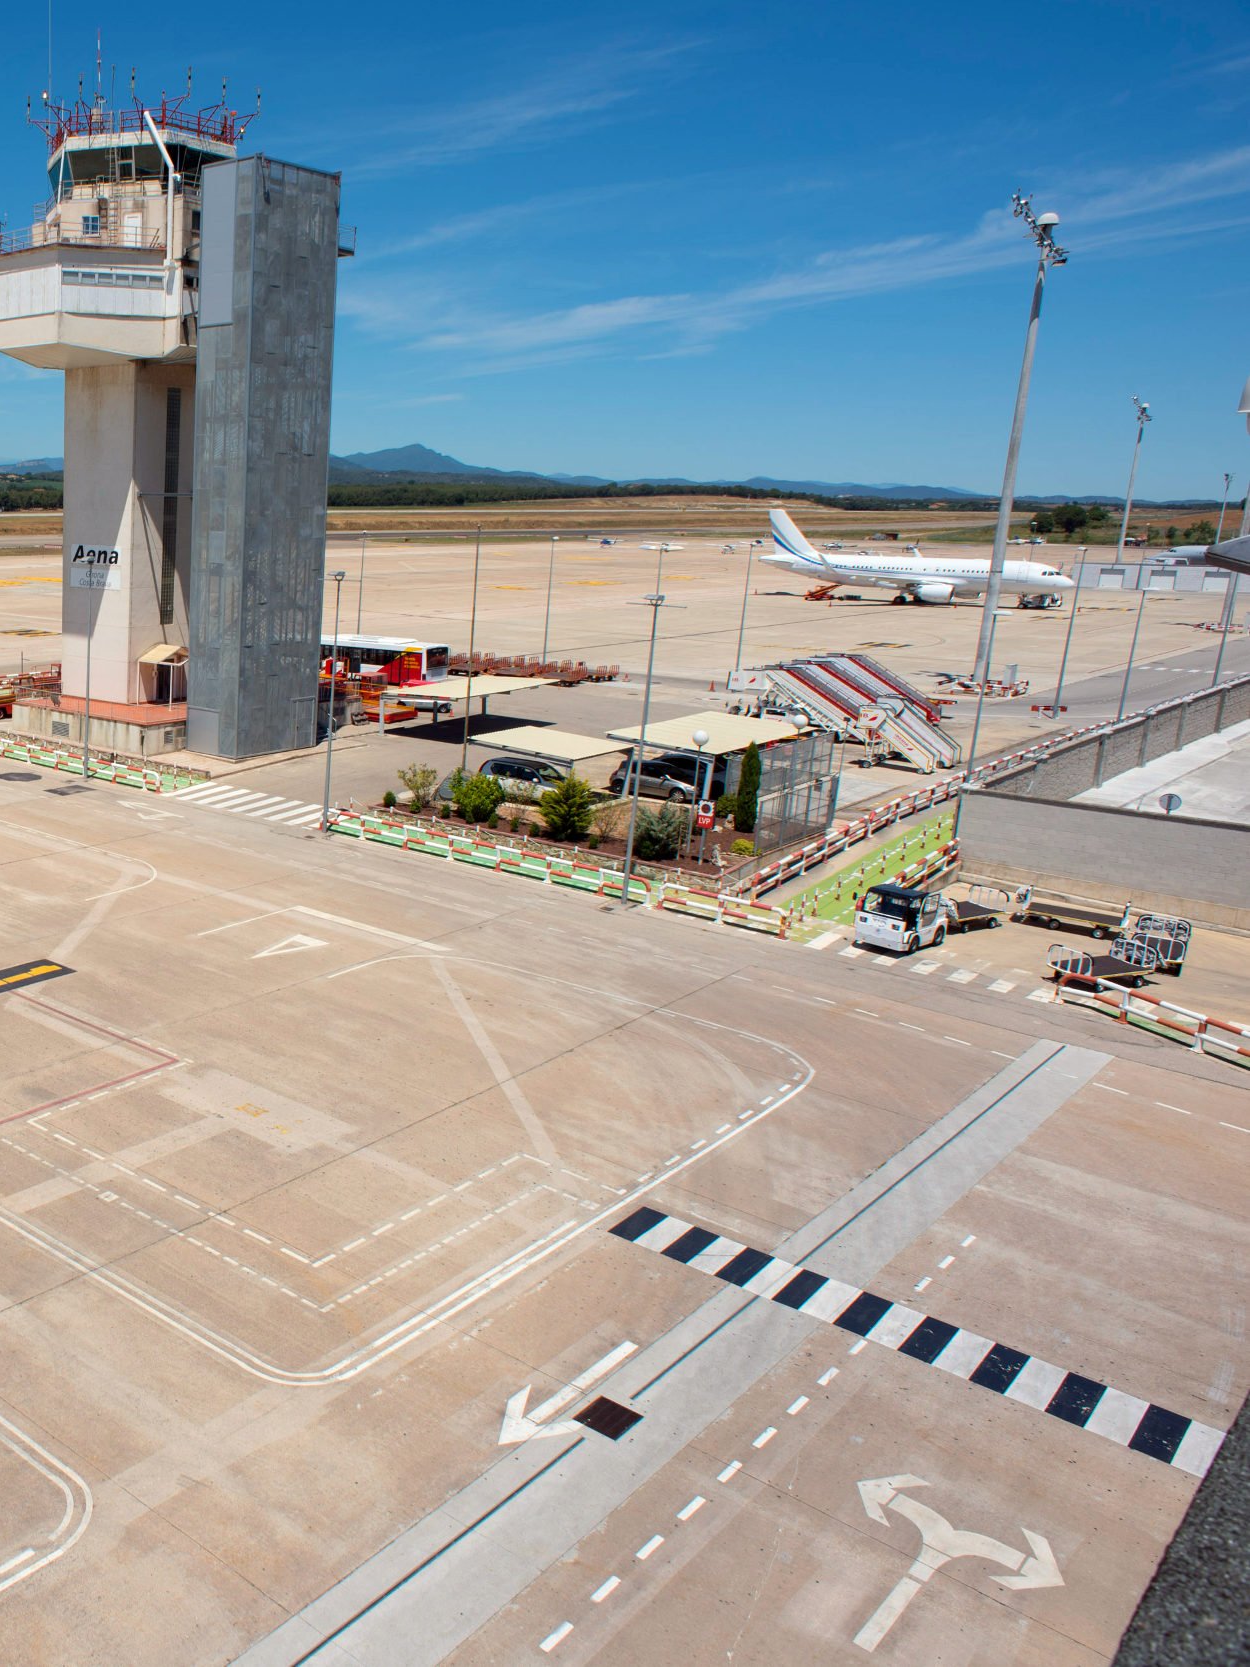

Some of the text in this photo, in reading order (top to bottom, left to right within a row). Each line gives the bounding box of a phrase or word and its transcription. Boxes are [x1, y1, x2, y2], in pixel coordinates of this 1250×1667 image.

[72, 544, 119, 565] Aena
[85, 570, 105, 579] Grona
[698, 816, 711, 825] LVP
